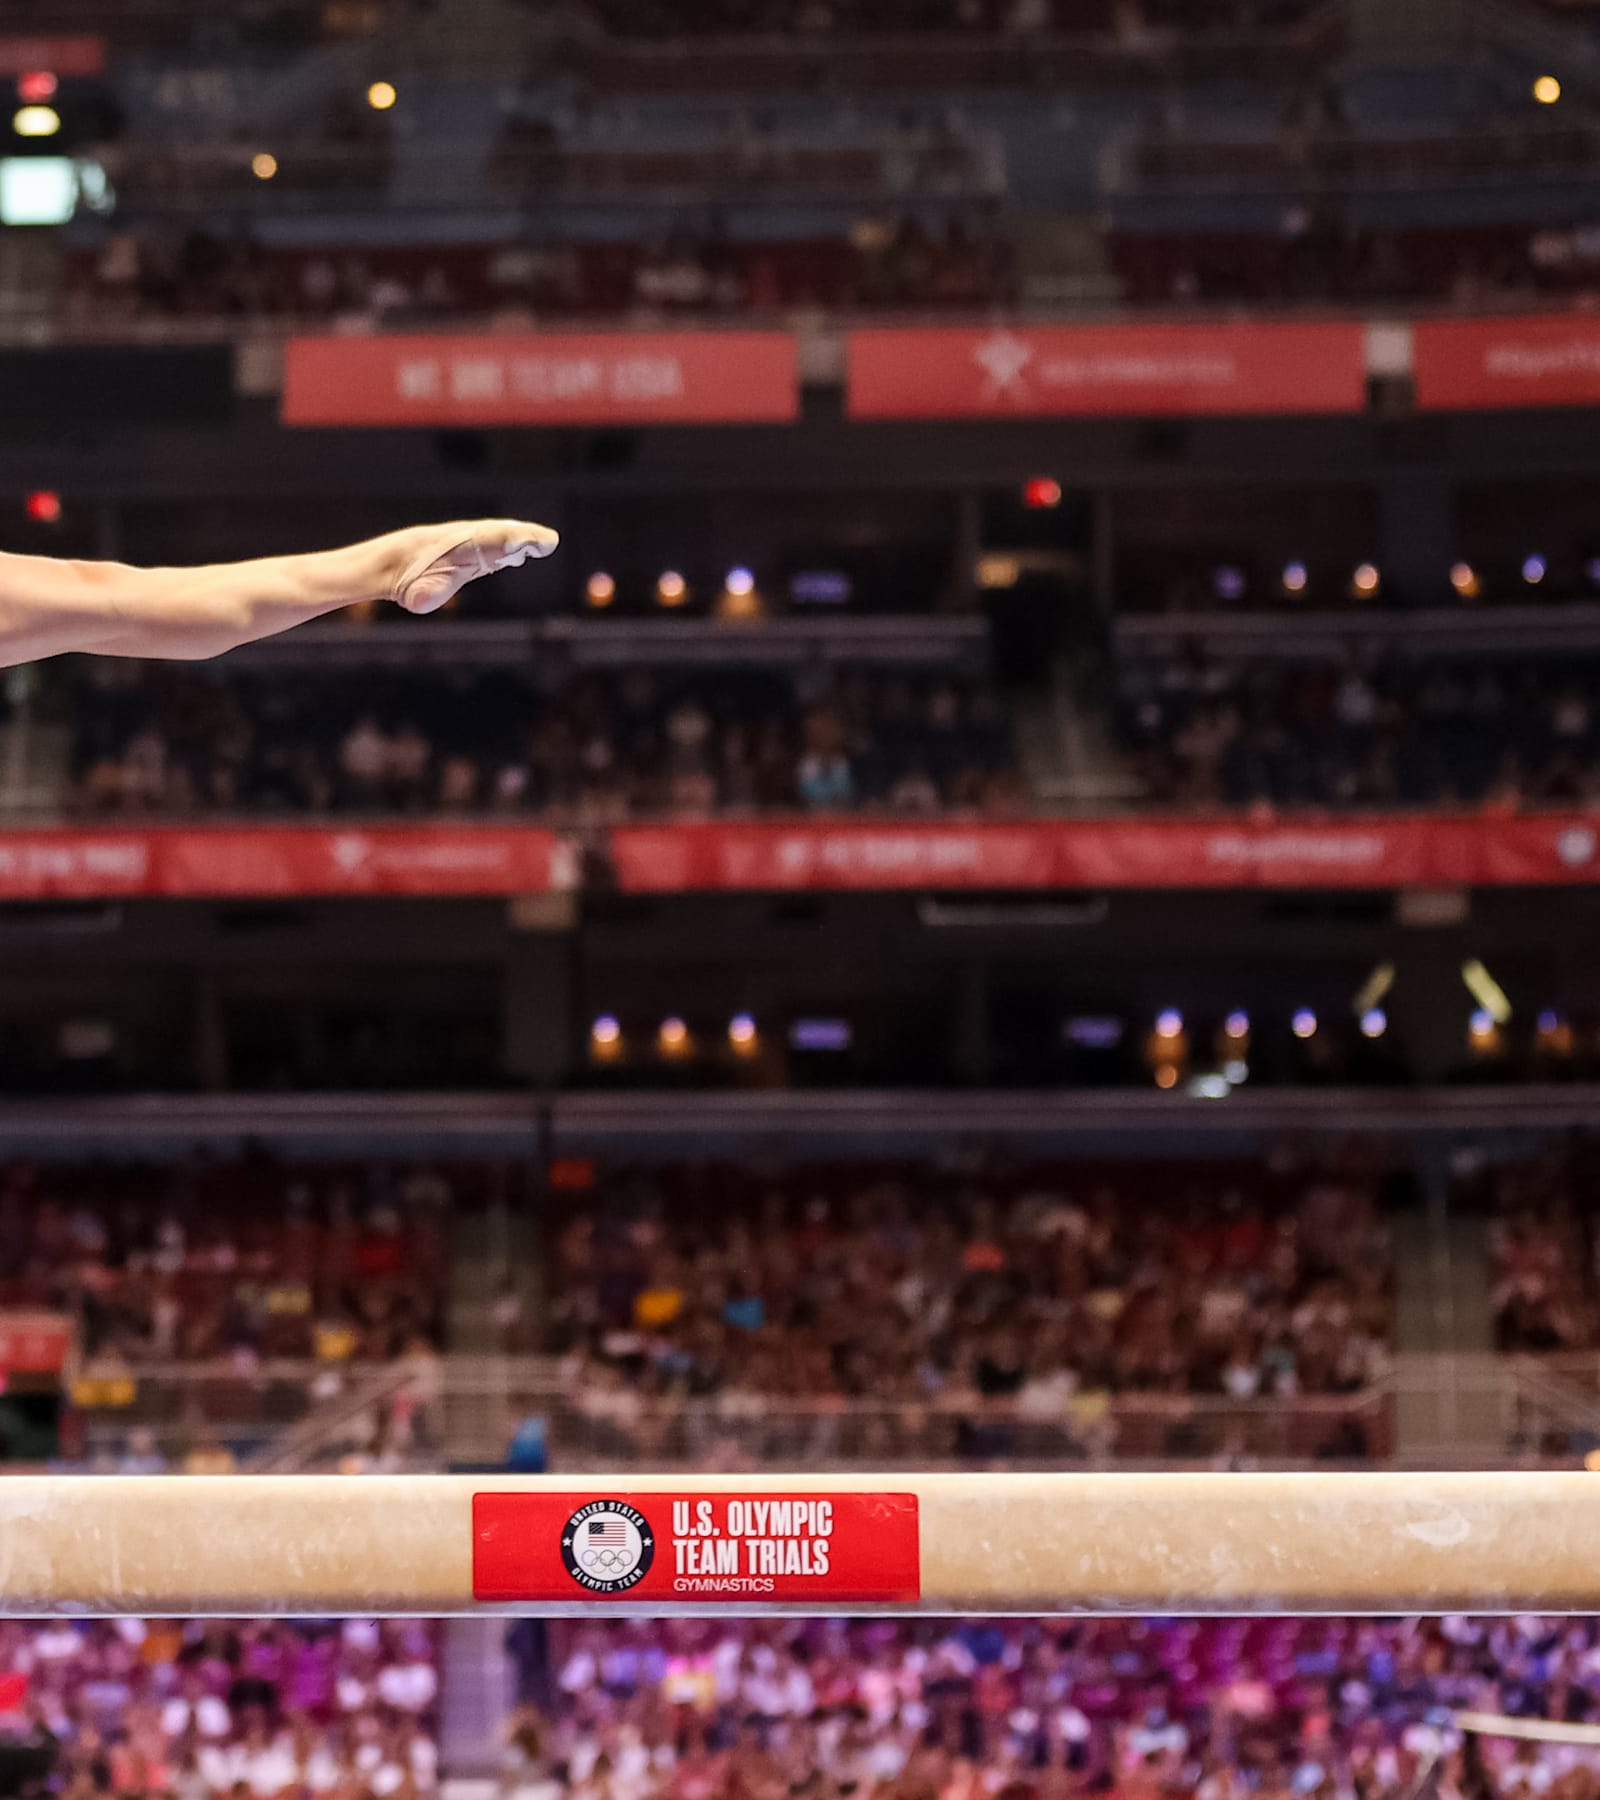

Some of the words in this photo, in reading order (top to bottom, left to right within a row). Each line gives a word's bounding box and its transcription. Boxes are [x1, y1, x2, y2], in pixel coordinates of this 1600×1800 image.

[569, 1502, 605, 1526] UNITED
[608, 1502, 645, 1526] STATES
[673, 1501, 720, 1536] U.S.
[727, 1501, 833, 1536] OLYMPIC
[673, 1539, 739, 1575] TEAM
[745, 1539, 830, 1575] TRIALS
[571, 1567, 613, 1592] OLYMPIC
[617, 1568, 644, 1589] TEAM
[673, 1578, 775, 1592] GYMNASTICS
